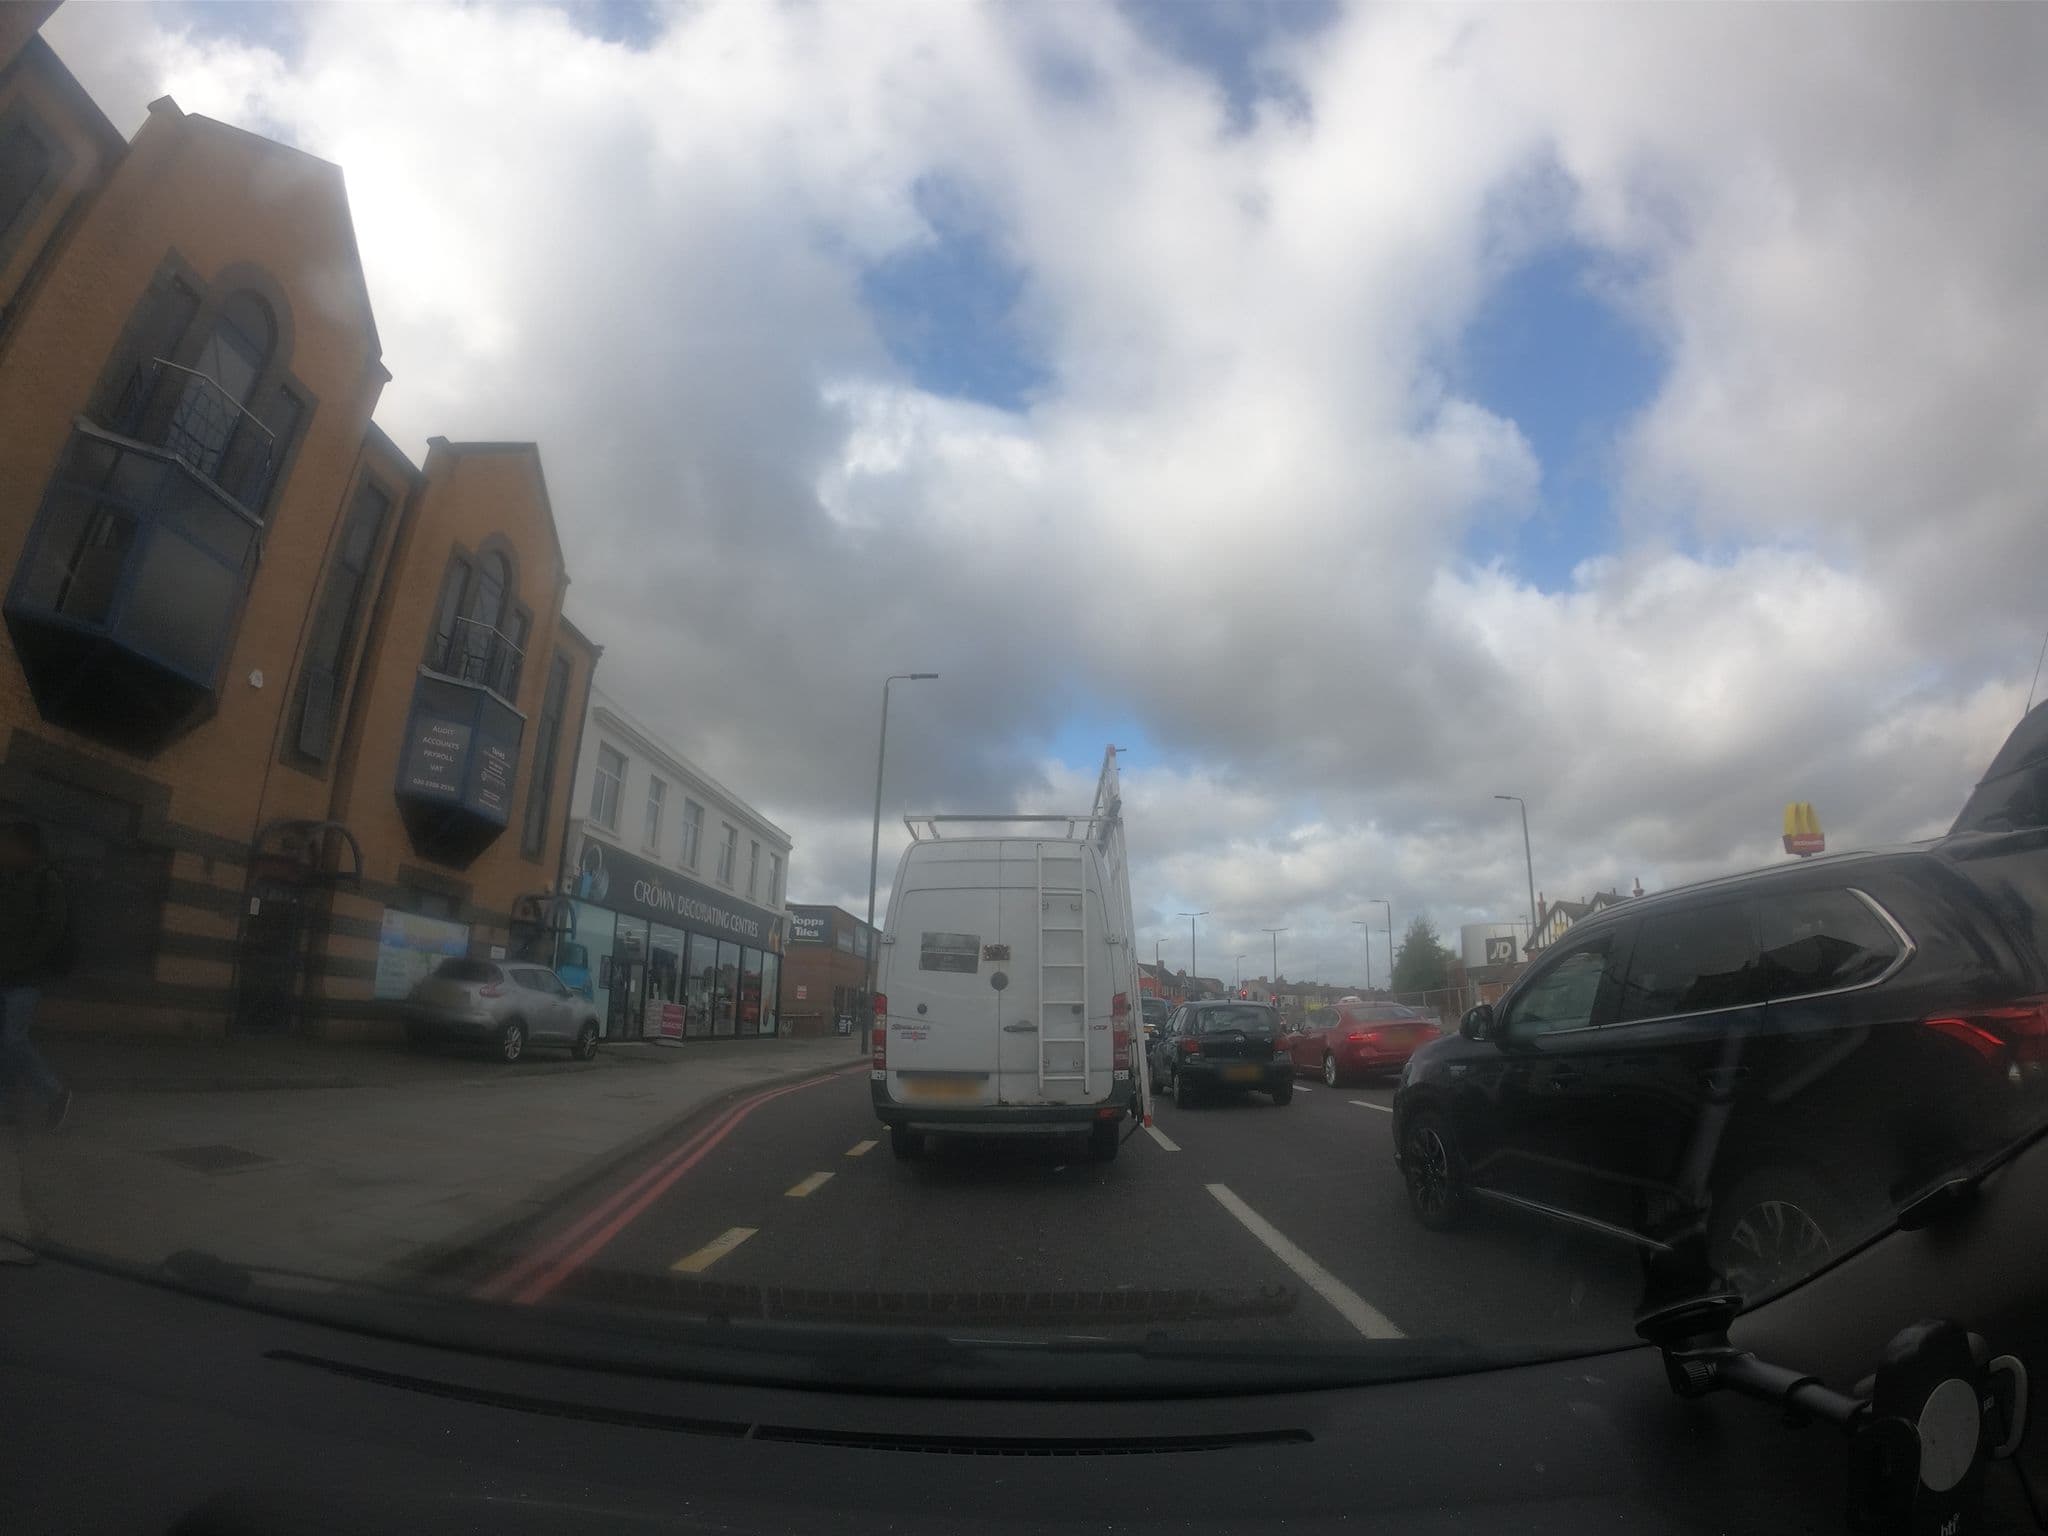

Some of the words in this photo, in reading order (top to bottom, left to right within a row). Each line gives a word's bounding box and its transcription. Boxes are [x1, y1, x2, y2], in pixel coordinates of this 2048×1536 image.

[633, 880, 676, 911] CROWN
[677, 895, 730, 929] DECORATING
[730, 914, 759, 938] CENTRES
[793, 914, 824, 927] Topps
[794, 927, 819, 937] Tiles
[1490, 942, 1512, 959] JD
